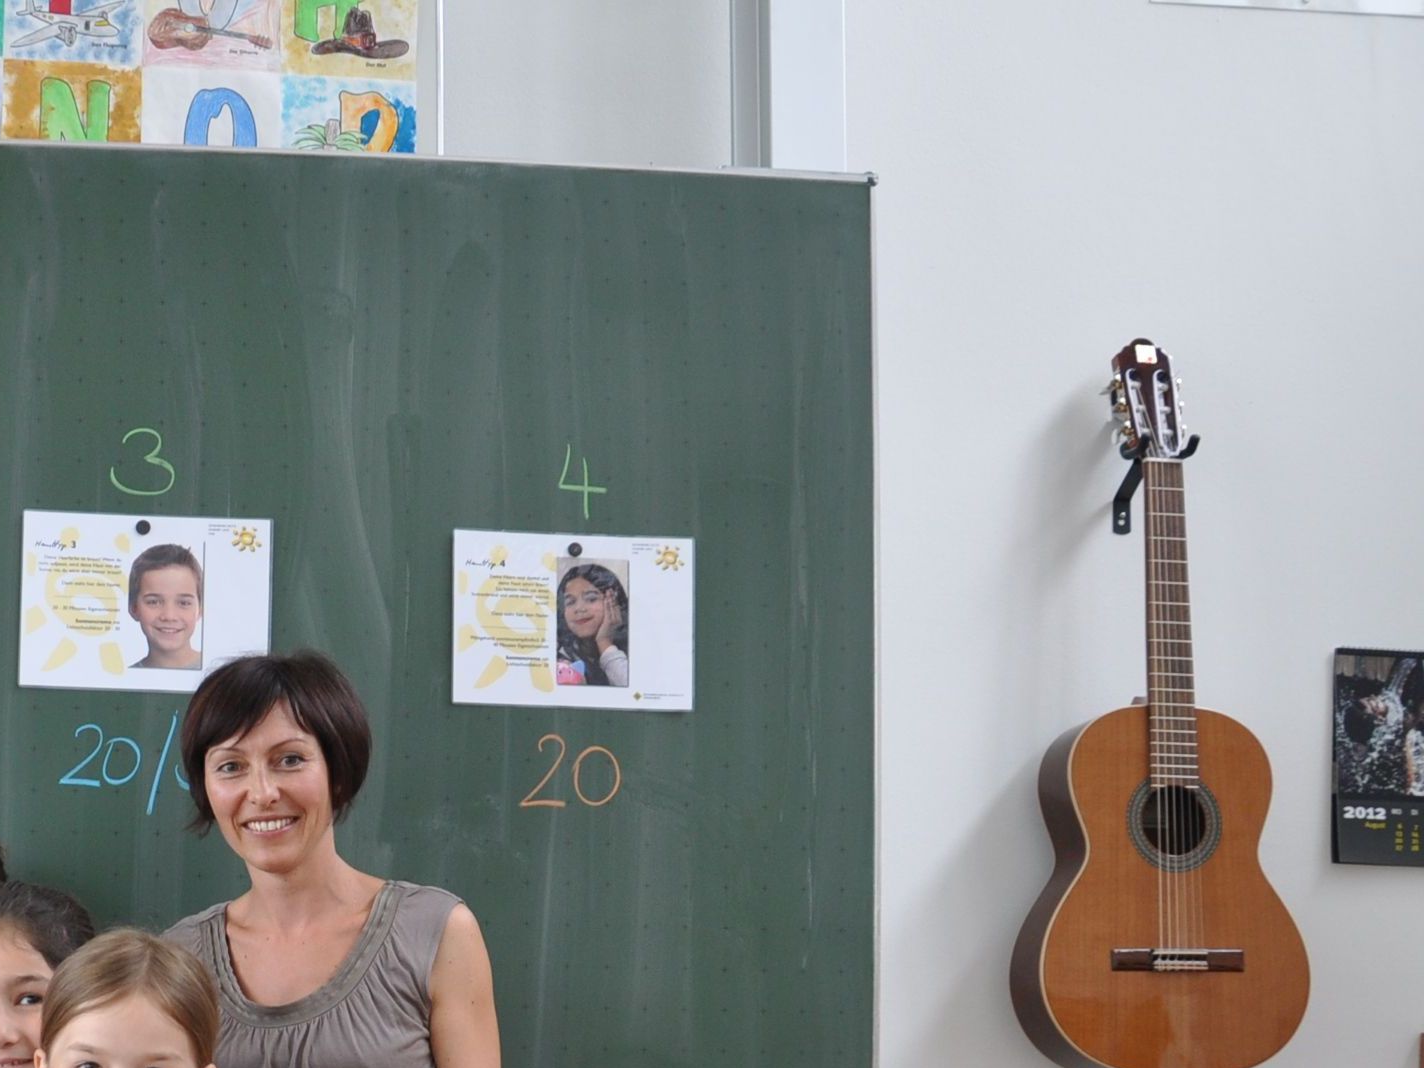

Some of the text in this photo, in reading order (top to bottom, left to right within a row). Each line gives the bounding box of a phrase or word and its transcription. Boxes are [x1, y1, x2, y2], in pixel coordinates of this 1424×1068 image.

[110, 427, 175, 496] 3
[558, 444, 608, 520] 4
[519, 733, 622, 808] 20
[1343, 805, 1386, 820] 2012
